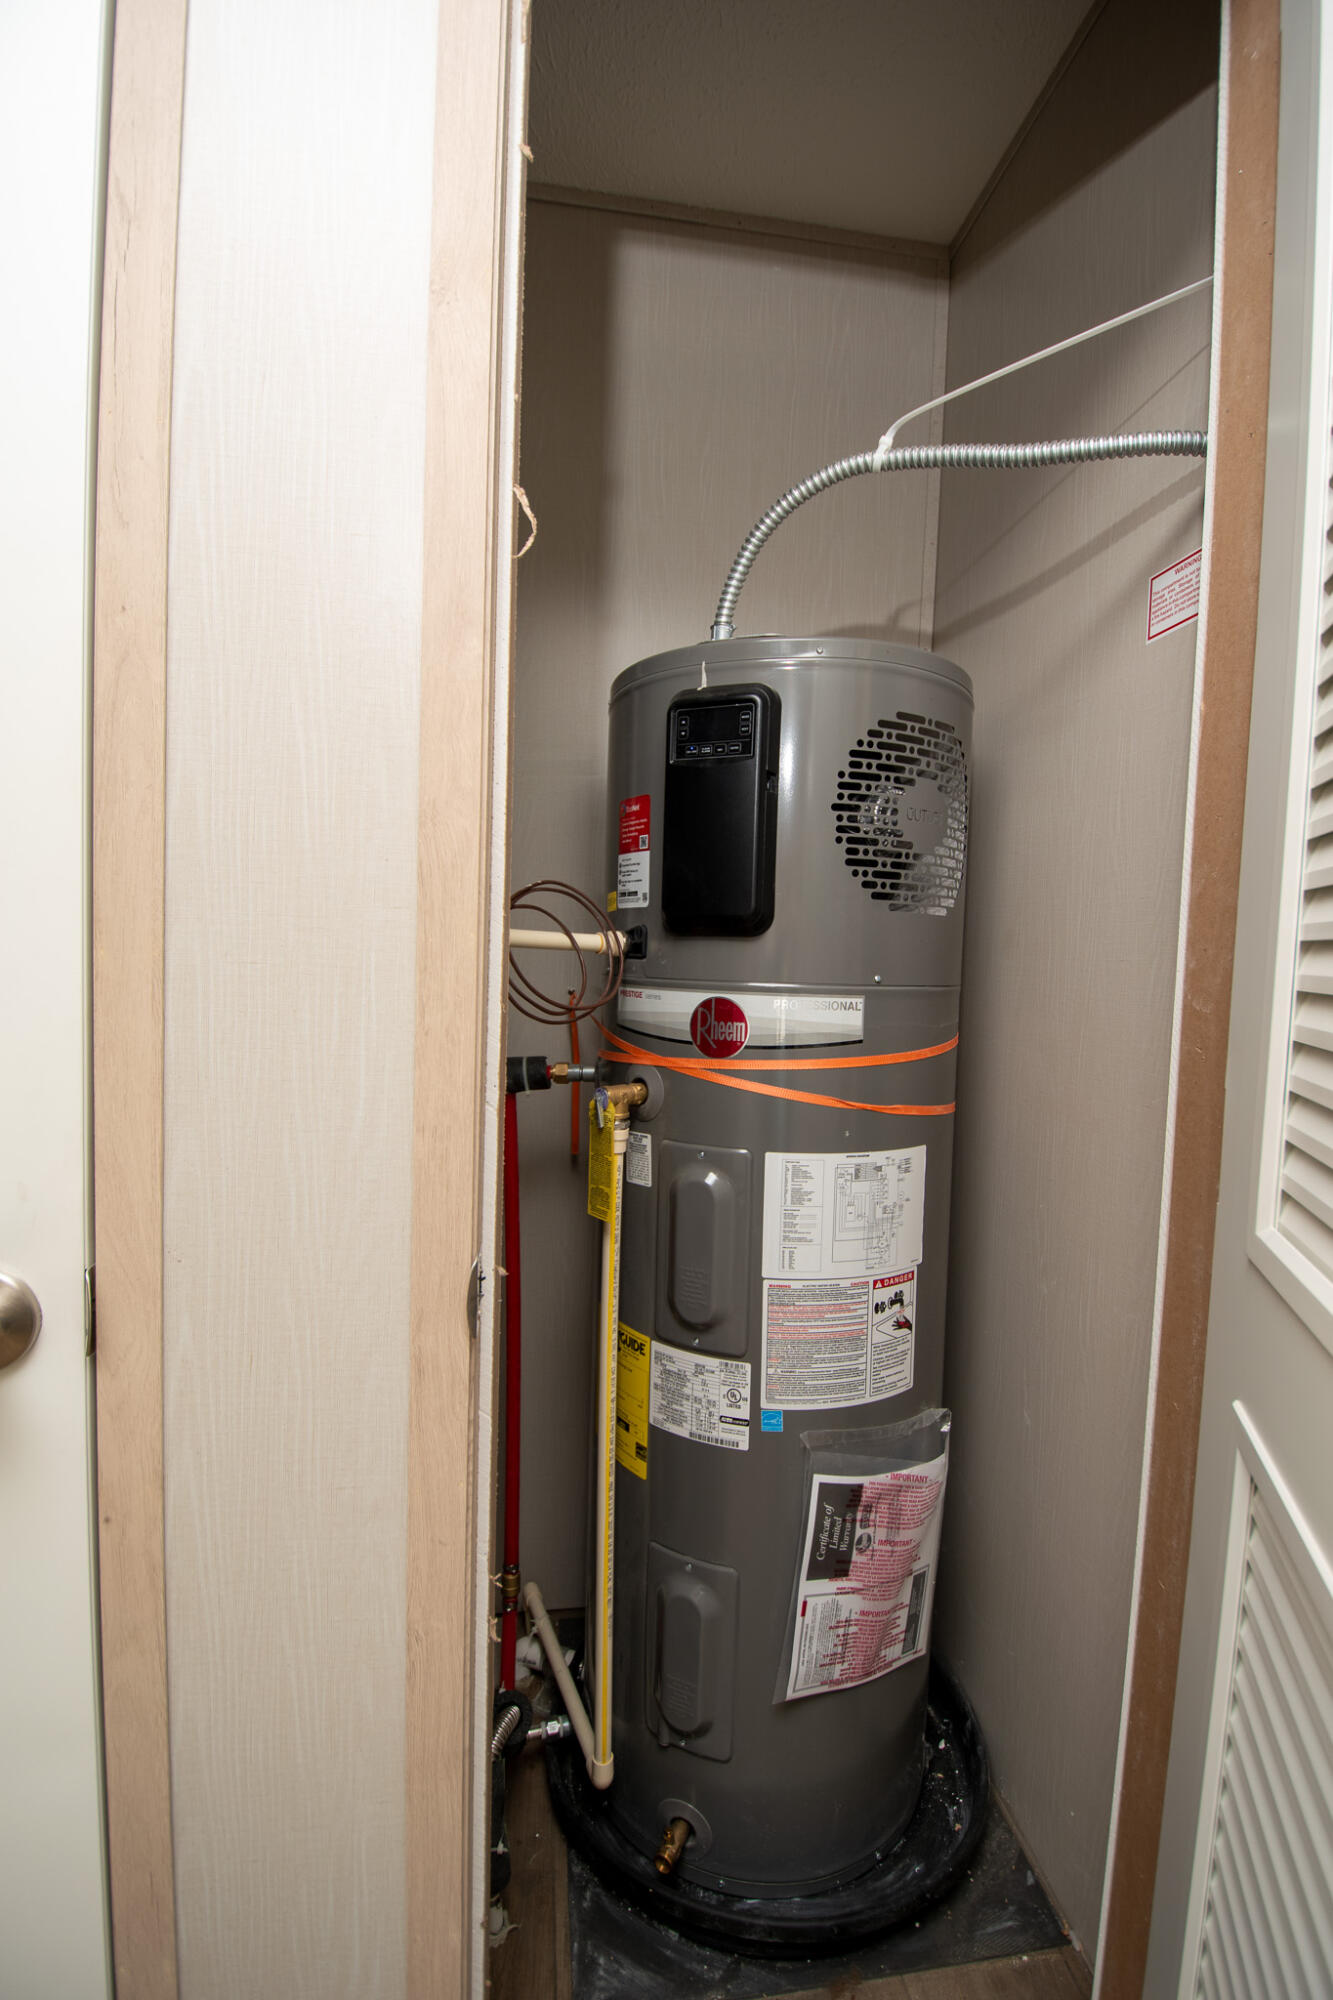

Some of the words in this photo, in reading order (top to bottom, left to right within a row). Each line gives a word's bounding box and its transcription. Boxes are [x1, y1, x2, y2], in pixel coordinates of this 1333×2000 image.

[773, 998, 862, 1012] PROSSIONAL
[696, 998, 746, 1049] Rheem
[883, 1271, 914, 1287] DANGER
[890, 1472, 929, 1484] IMPORTANT
[823, 1502, 836, 1516] of
[816, 1516, 831, 1562] Certificate
[828, 1516, 842, 1550] Limited
[877, 1538, 914, 1548] IMPORTANT
